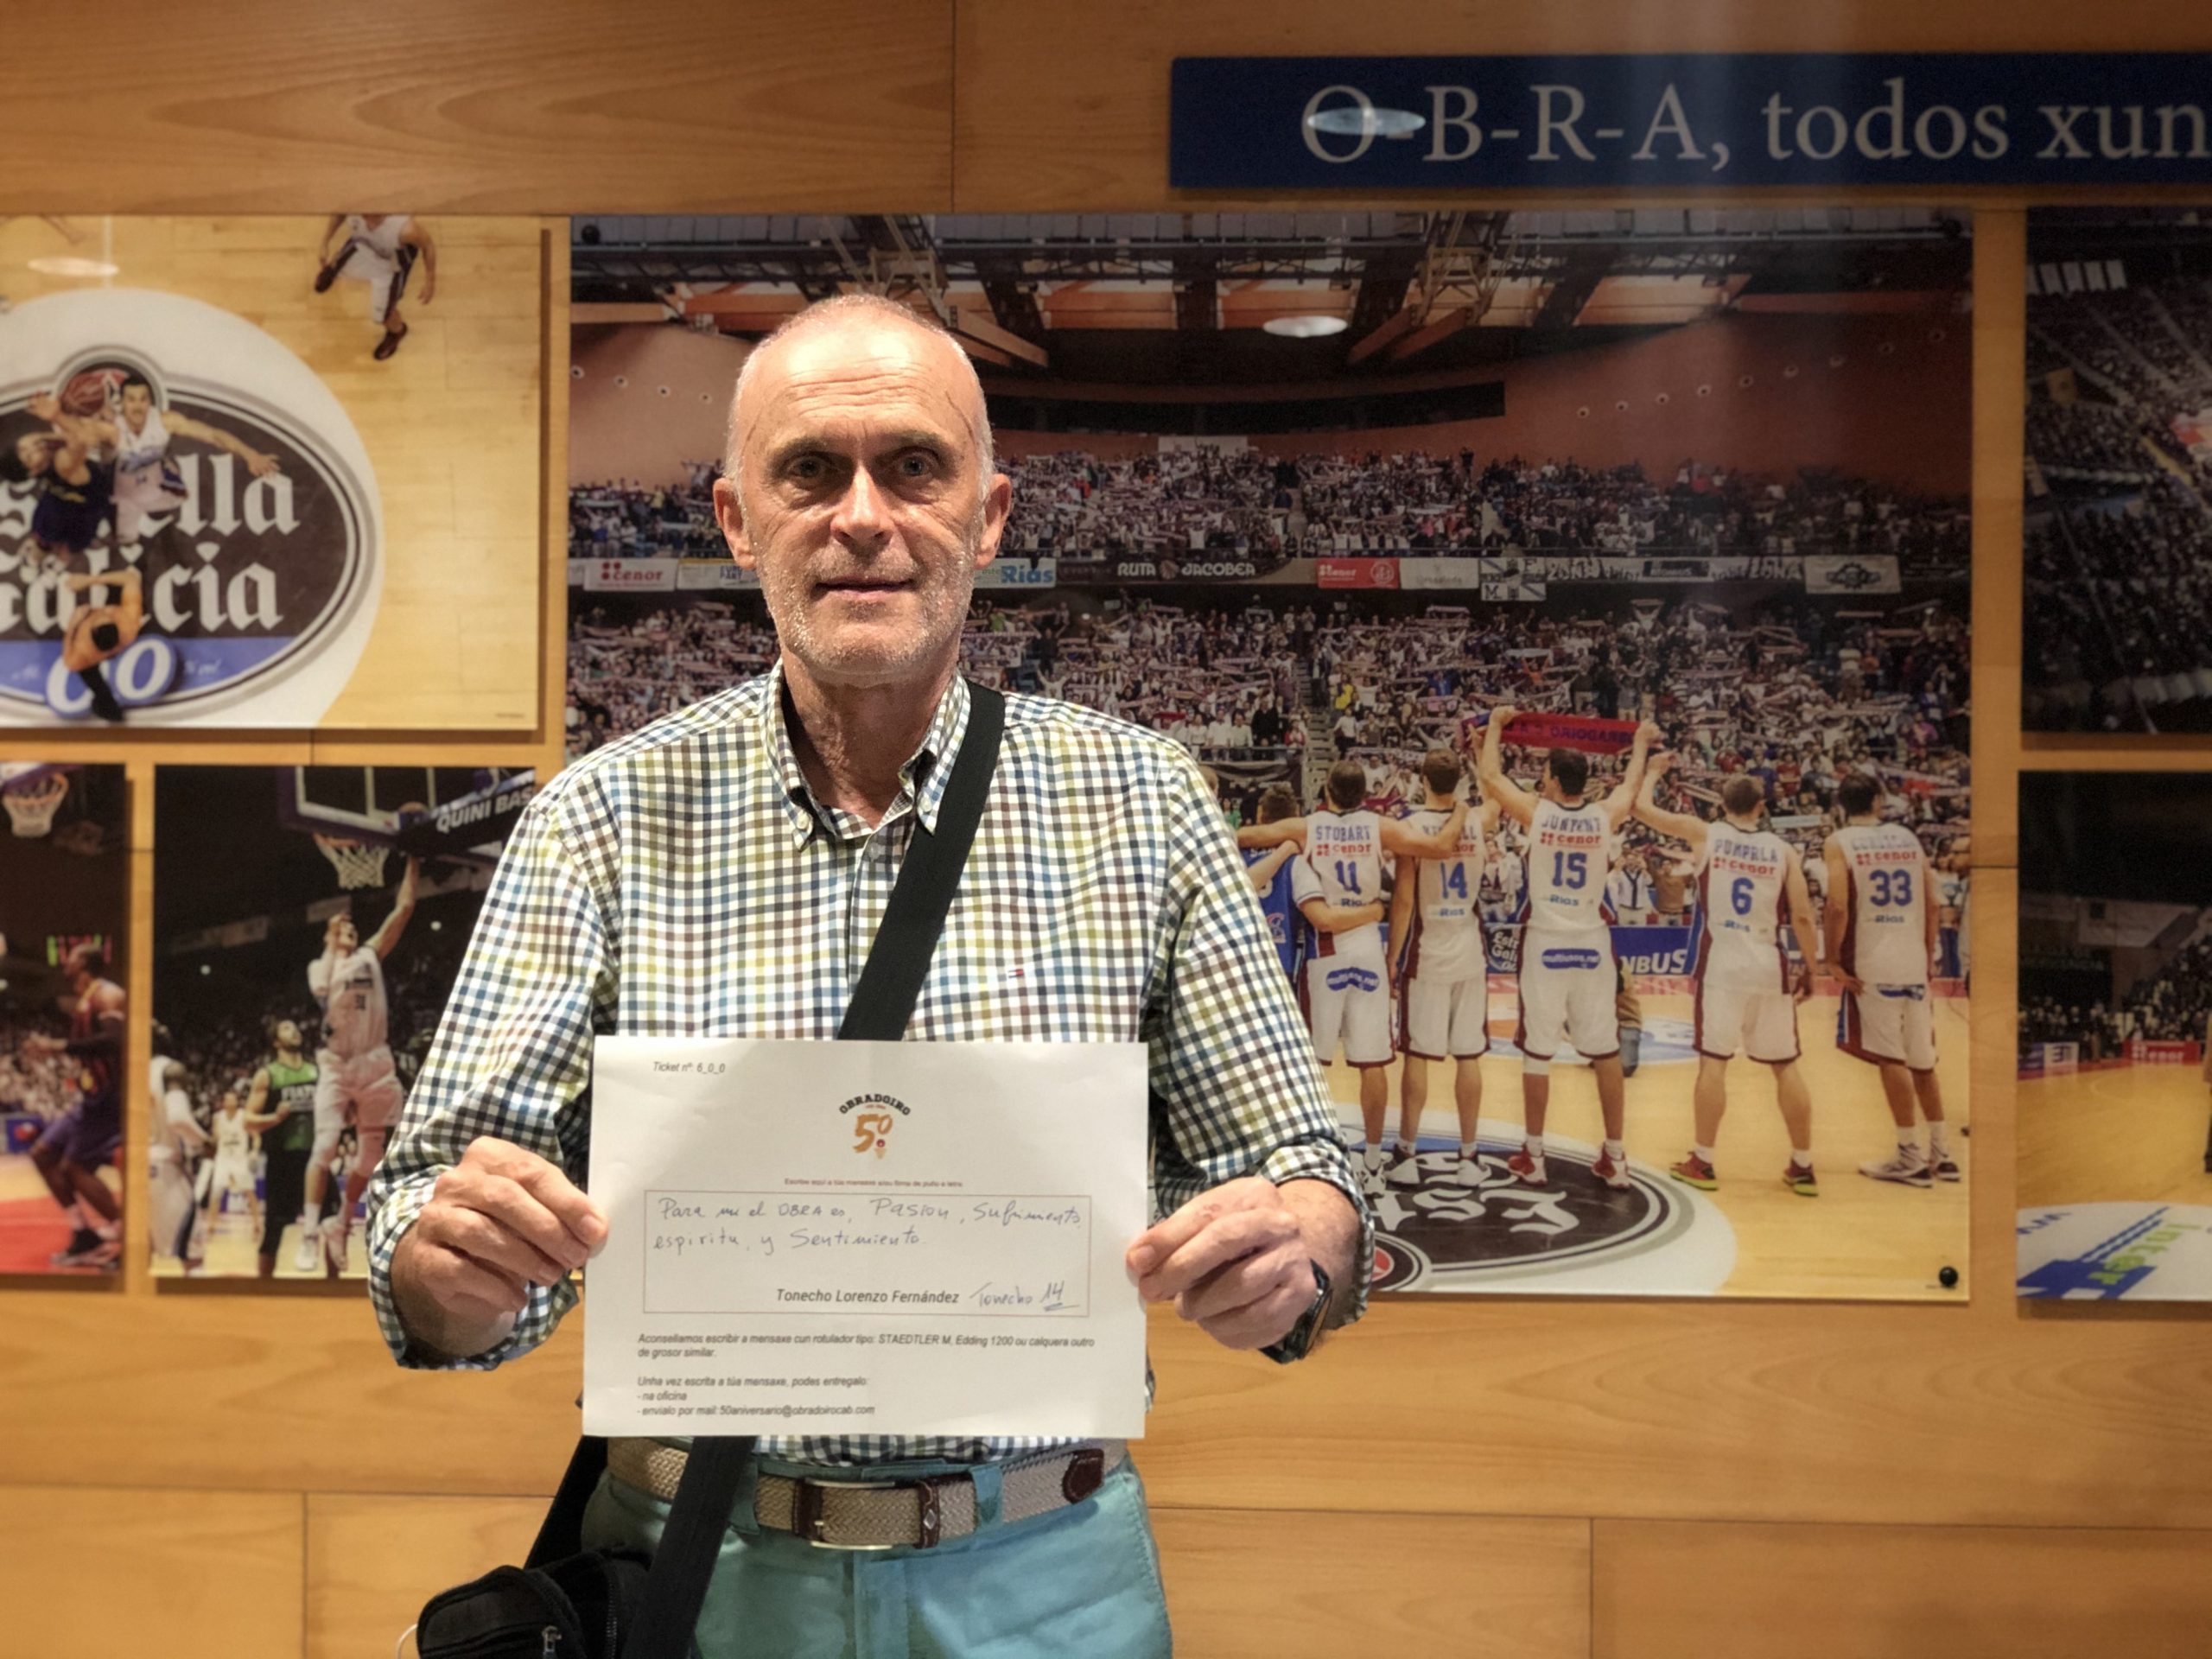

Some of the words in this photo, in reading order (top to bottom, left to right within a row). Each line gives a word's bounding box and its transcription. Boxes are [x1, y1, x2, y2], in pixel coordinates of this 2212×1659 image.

[1762, 77, 2009, 162] todos
[2036, 103, 2212, 162] xun
[1117, 562, 1156, 576] RUTA
[1181, 562, 1255, 576] JACOBEA
[435, 798, 492, 834] QUINI
[1315, 825, 1371, 842] STOBART
[1557, 834, 1601, 844] cenor
[1332, 843, 1372, 854] cenor
[1874, 851, 1917, 861] cenor
[1552, 850, 1587, 889] 15
[1729, 860, 1776, 875] cenor
[1440, 861, 1468, 899] 14
[1869, 869, 1912, 907] 33
[1731, 877, 1755, 916] 6
[653, 1061, 679, 1072] Ticket
[839, 1093, 911, 1116] OBRADOIRO
[852, 1113, 893, 1154] 50
[658, 1197, 705, 1220] Para
[760, 1235, 775, 1256] y
[777, 1288, 832, 1303] Tonecho
[836, 1288, 888, 1303] Lorenzo
[892, 1288, 959, 1304] Fernández
[705, 1333, 740, 1344] escribir
[812, 1334, 854, 1344] rotulador
[878, 1334, 939, 1344] STAEDTLER
[956, 1335, 988, 1347] Edding
[991, 1336, 1014, 1346] 1200
[1015, 1338, 1027, 1346] ou
[1028, 1336, 1069, 1348] calquera
[1071, 1337, 1095, 1347] outro
[638, 1347, 650, 1357] de
[652, 1349, 683, 1359] grosor
[638, 1376, 663, 1387] Unha
[791, 1376, 820, 1389] podes
[642, 1393, 654, 1402] na
[657, 1390, 687, 1402] oficina
[677, 1408, 693, 1418] por
